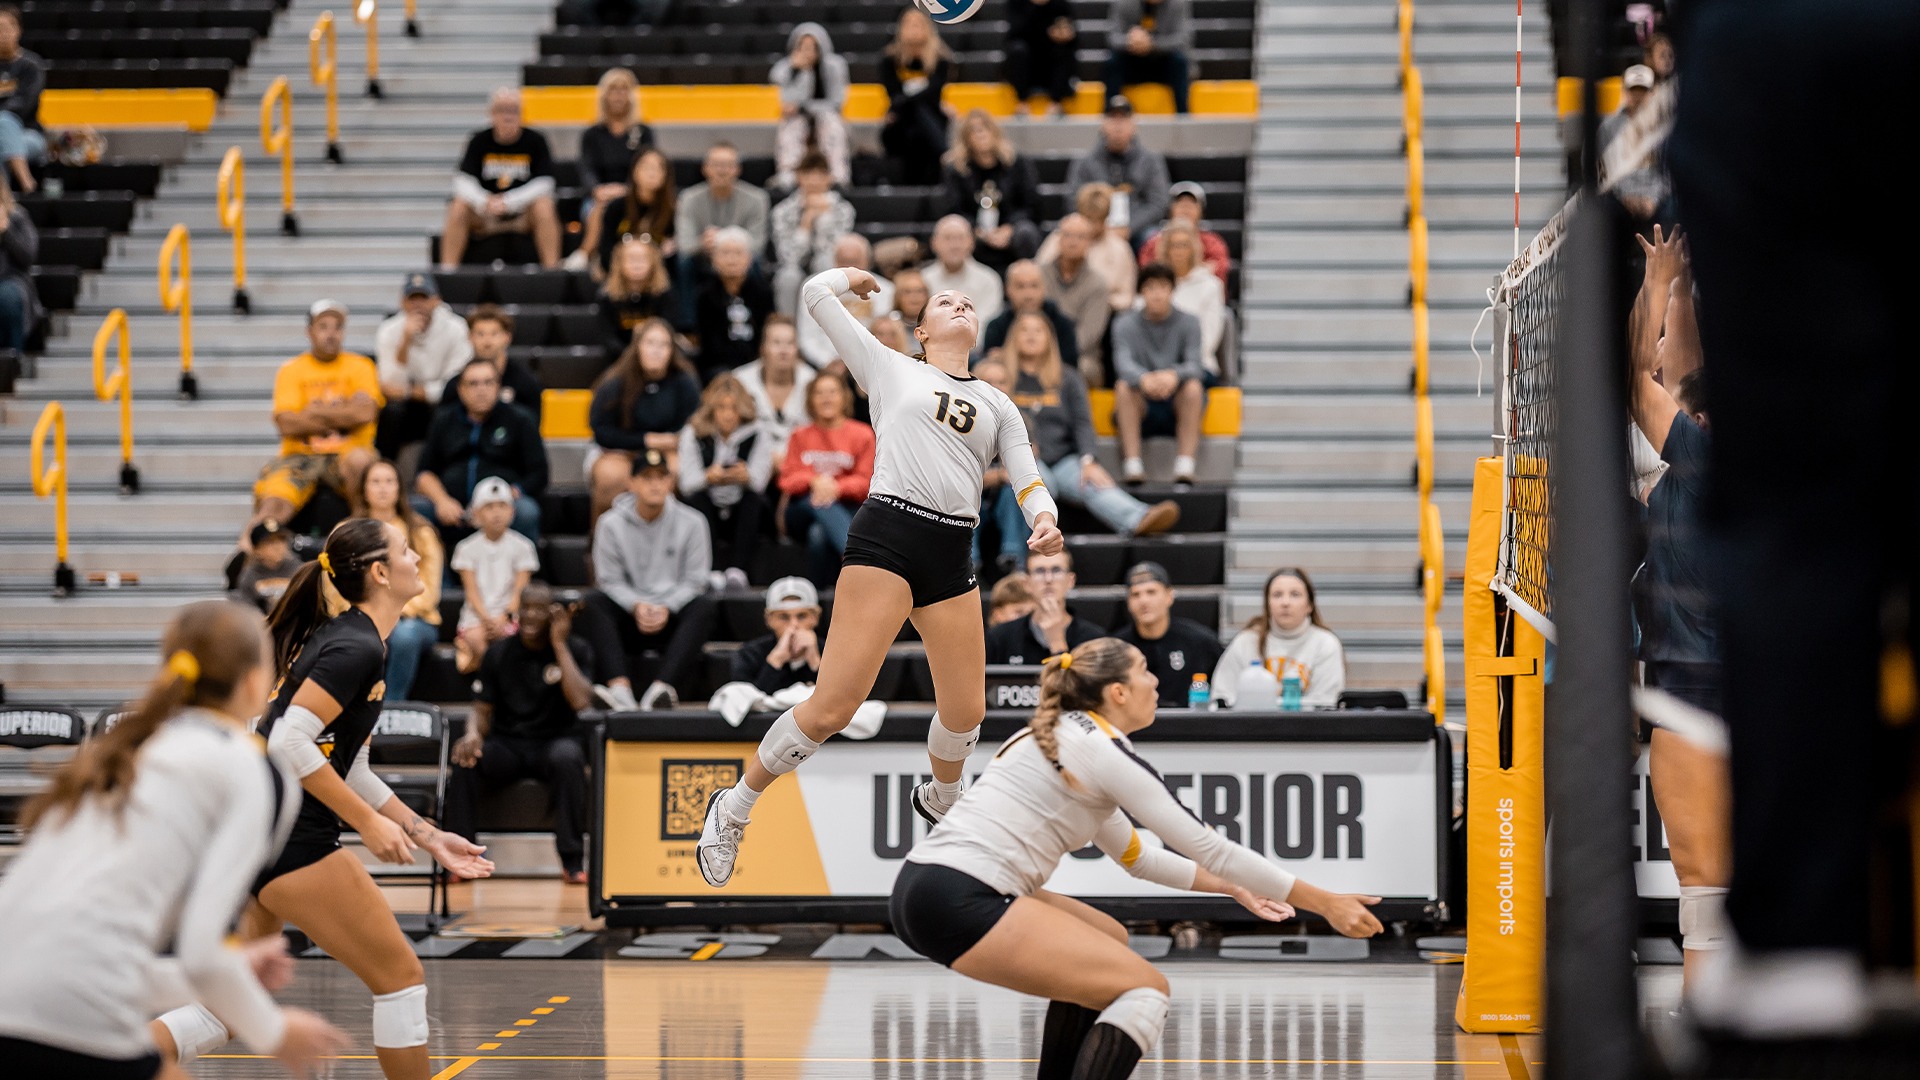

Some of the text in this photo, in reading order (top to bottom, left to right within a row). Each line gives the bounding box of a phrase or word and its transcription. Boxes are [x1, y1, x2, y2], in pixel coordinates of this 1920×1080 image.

[933, 390, 977, 434] 13
[906, 505, 940, 522] UNDER
[940, 517, 971, 528] ARMOUR
[1496, 798, 1516, 936] sports imports
[1480, 1013, 1499, 1022] (800)
